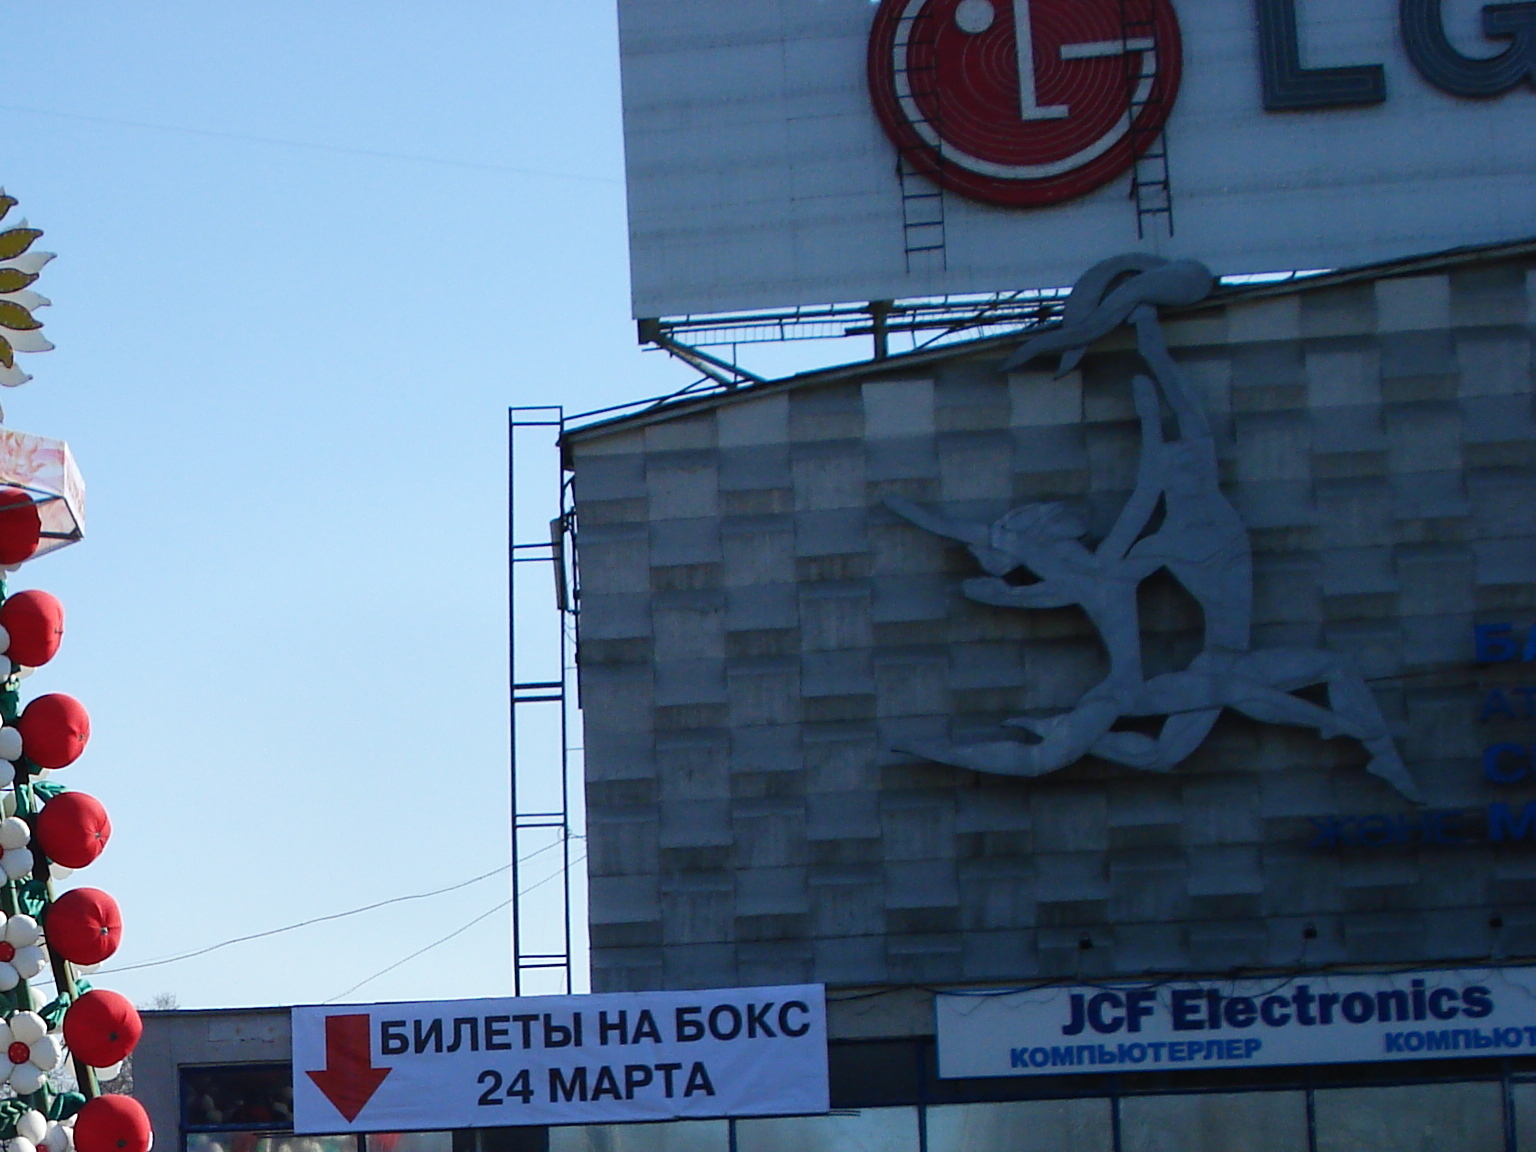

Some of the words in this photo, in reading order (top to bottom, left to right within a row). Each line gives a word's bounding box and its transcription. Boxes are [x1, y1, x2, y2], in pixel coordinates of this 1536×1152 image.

[381, 1012, 583, 1056] БИЛЕТЫ
[599, 1009, 663, 1048] НА
[676, 1000, 812, 1043] БОКС
[1062, 988, 1157, 1036] JCF
[1172, 978, 1494, 1031] Electronics
[1010, 1037, 1262, 1069] КОМПЬЮТЕРЛЕР
[477, 1069, 534, 1107] 24
[549, 1061, 716, 1104] МАРТА
